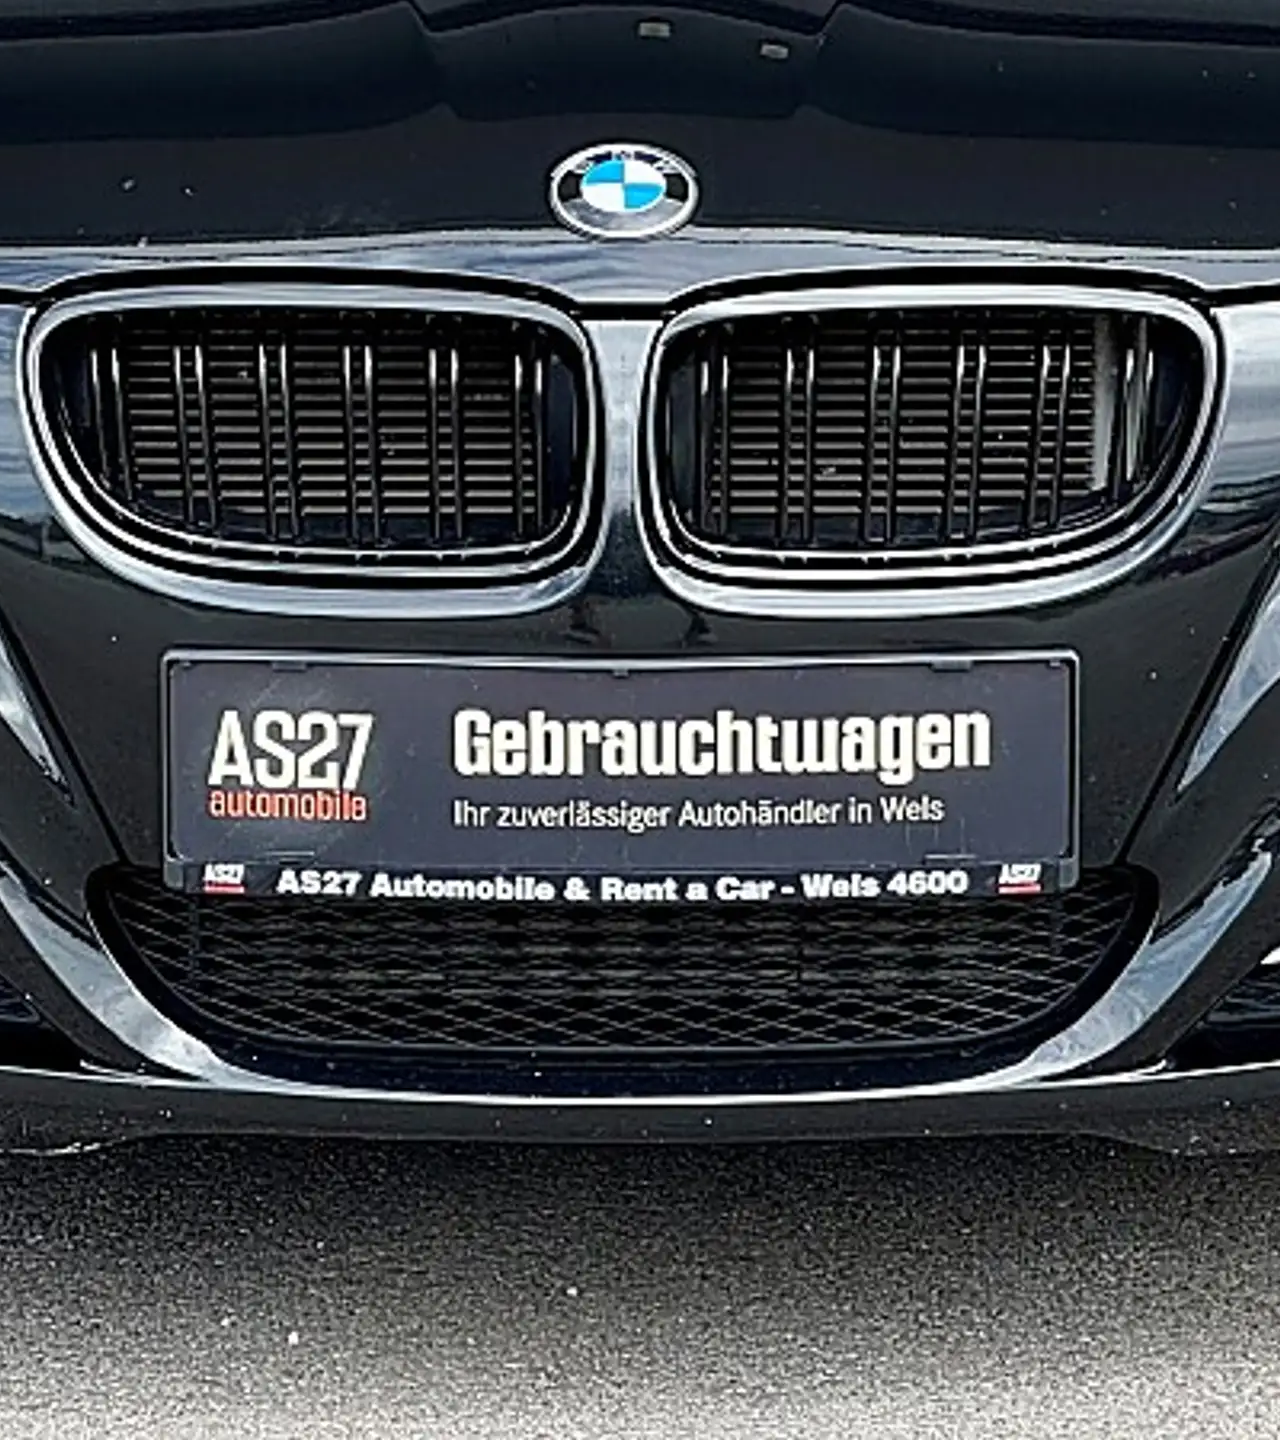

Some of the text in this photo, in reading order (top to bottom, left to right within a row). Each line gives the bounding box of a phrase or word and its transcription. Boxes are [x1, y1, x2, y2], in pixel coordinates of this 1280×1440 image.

[208, 710, 373, 789] AS27
[453, 708, 991, 786] Gebrauchtwagen
[210, 789, 367, 821] automobile
[453, 794, 945, 834] Ihr zuverlässiger Autohändler in Wels
[276, 868, 362, 895] AS27
[370, 872, 556, 901] Automobile
[563, 877, 591, 901] &
[600, 877, 678, 901] Rent
[684, 883, 708, 901] a
[715, 876, 775, 900] Car
[800, 873, 881, 898] Wels
[887, 870, 969, 895] 4600
